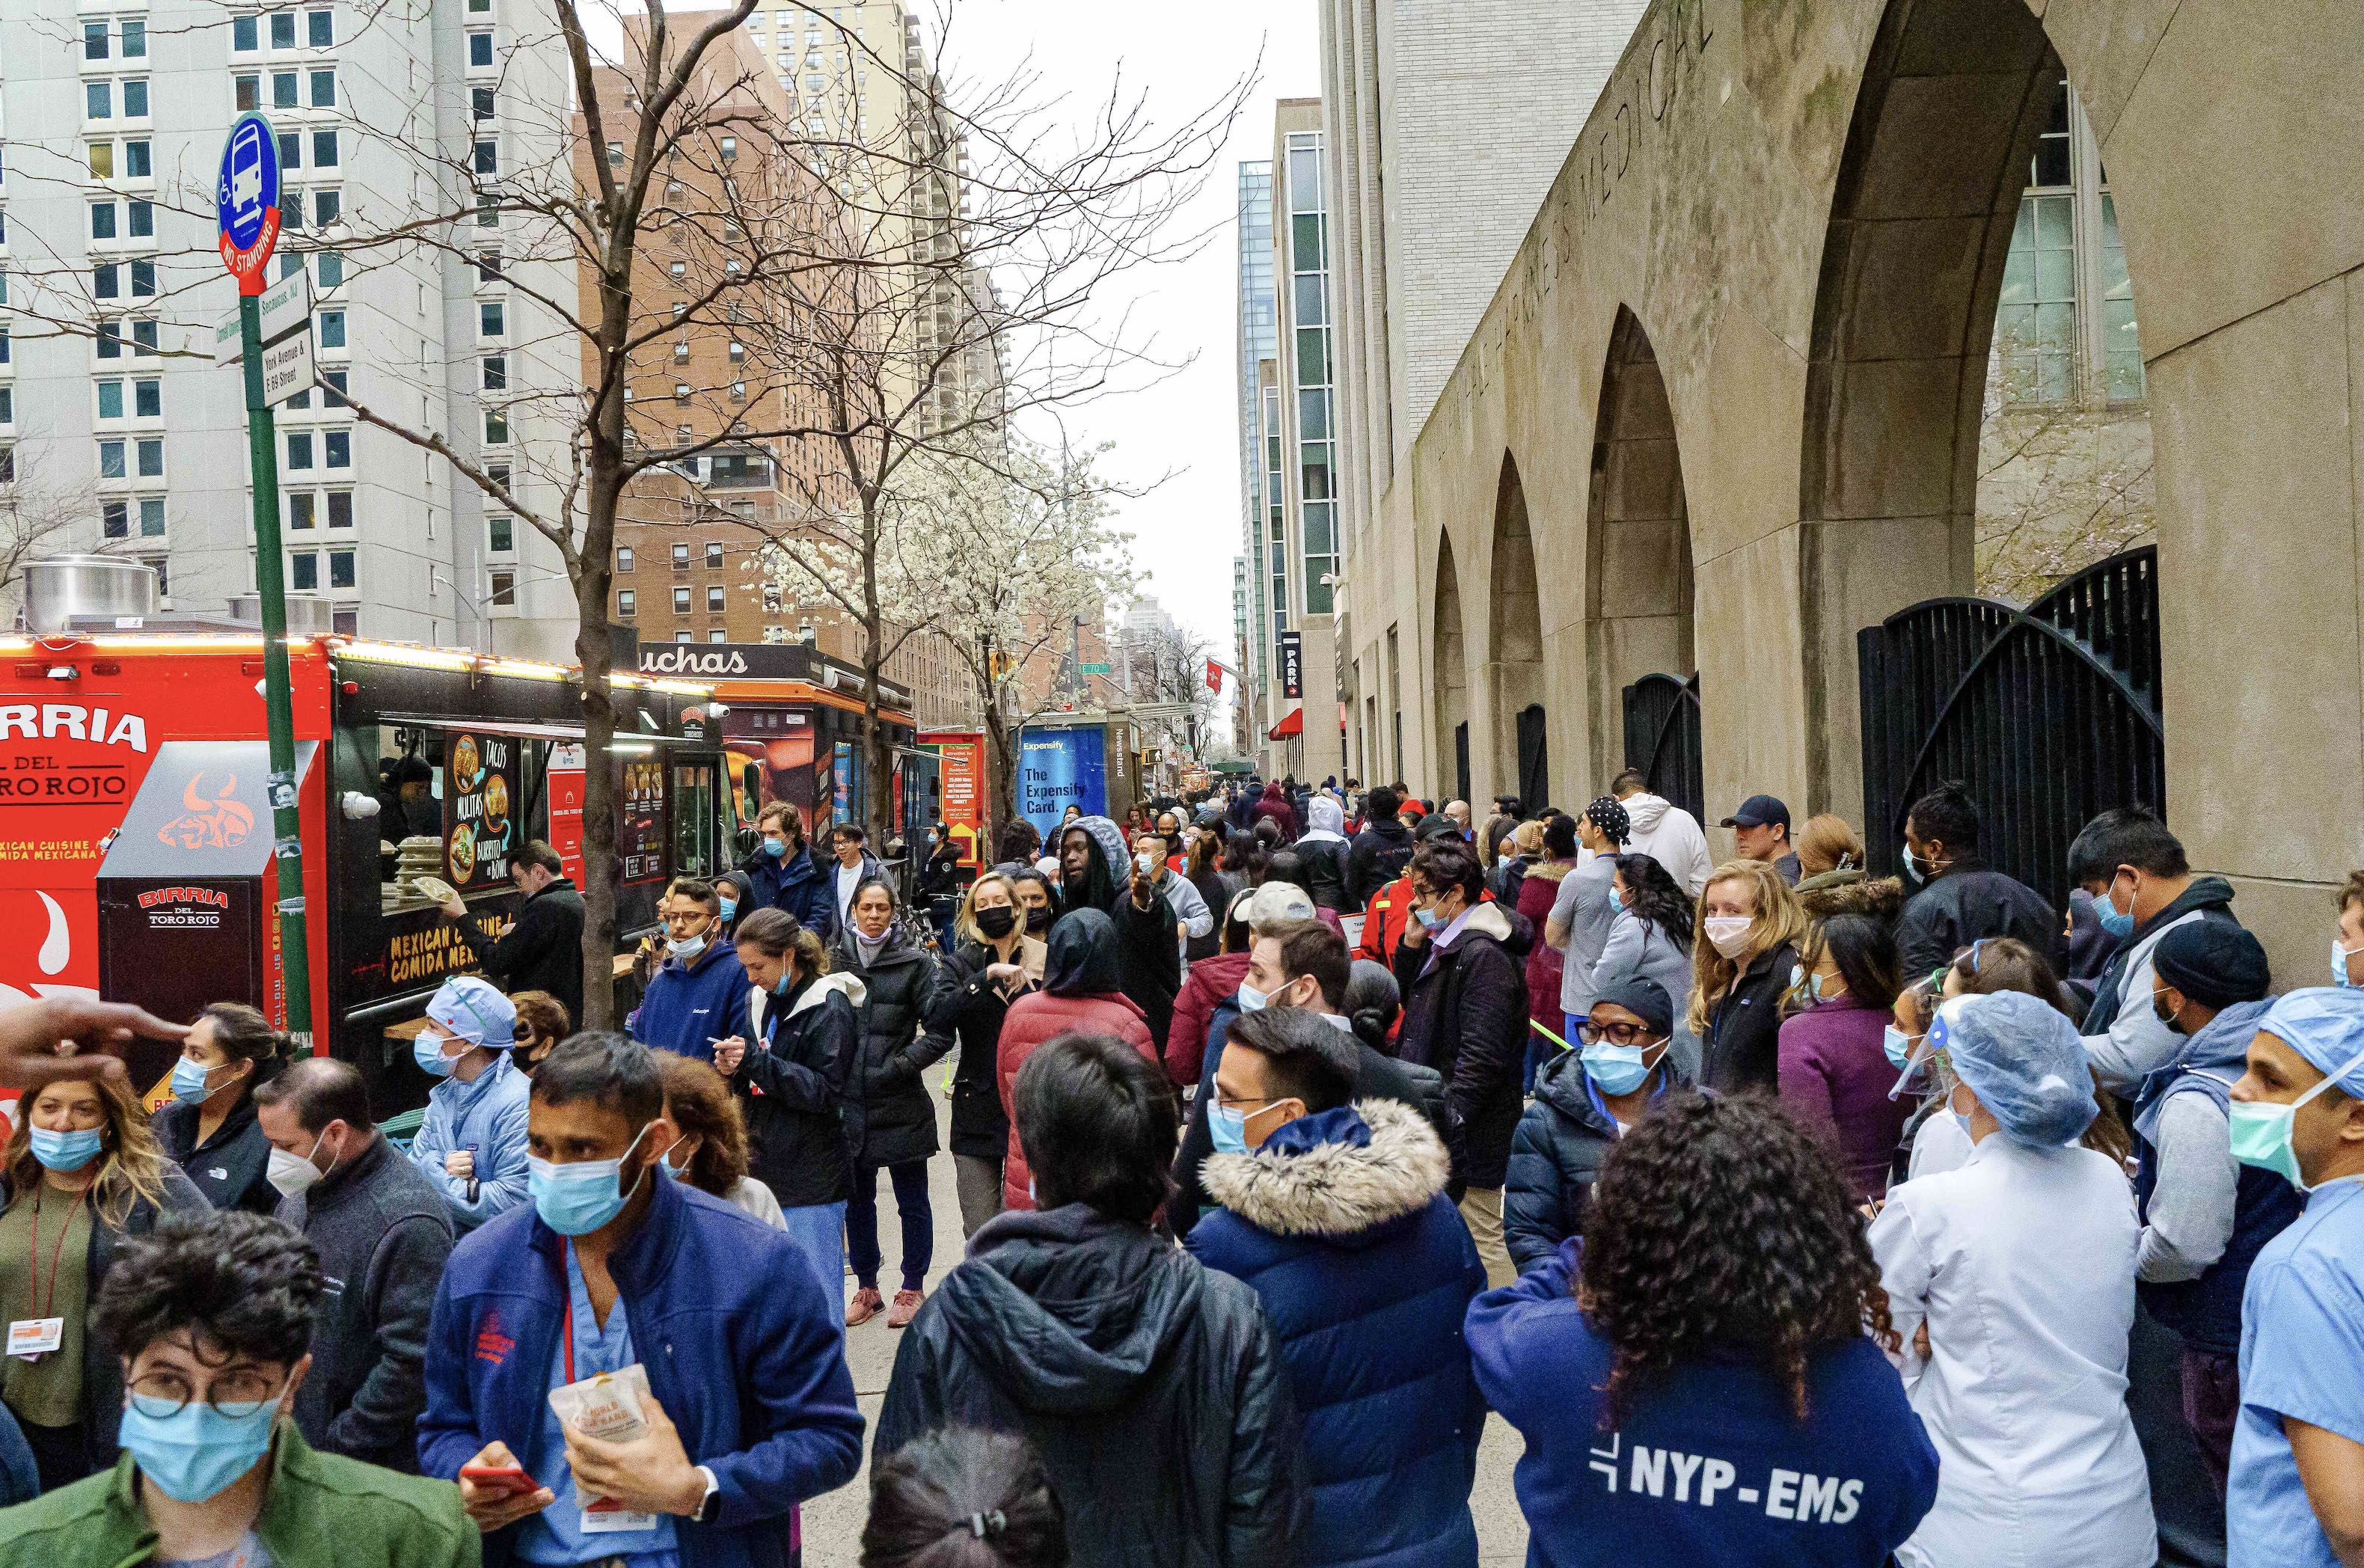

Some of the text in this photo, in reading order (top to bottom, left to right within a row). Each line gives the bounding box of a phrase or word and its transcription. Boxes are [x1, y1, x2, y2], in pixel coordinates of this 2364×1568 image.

[1578, 0, 1714, 236] MEDICAL
[224, 220, 273, 272] NO STANDING
[290, 281, 298, 298] NJ
[265, 340, 304, 372] York Avenue &
[266, 367, 296, 393] E 69 Street
[1090, 664, 1100, 673] 70
[1287, 649, 1298, 686] PARK
[680, 706, 705, 725] BIRRIA
[0, 703, 147, 753] RRIA
[486, 739, 507, 770] TACOS
[1023, 741, 1063, 752] Expensify
[1116, 729, 1125, 778] Newsstand
[14, 756, 60, 770] DEL
[1025, 768, 1047, 781] The
[45, 776, 126, 797] ROJO
[1026, 782, 1085, 800] Expensify
[457, 792, 483, 821] MULITAS
[1026, 800, 1059, 814] Card.
[34, 850, 97, 860] MEXICANA
[39, 840, 90, 851] CUISINE
[477, 839, 501, 861] BURRITO
[491, 859, 508, 880] BOWL
[138, 886, 228, 909] BIRRIA
[150, 916, 220, 925] TORO ROJO
[391, 925, 450, 961] MEXICAN
[391, 950, 444, 983] COMIDA
[1629, 1445, 1864, 1525] NYP-EMS
